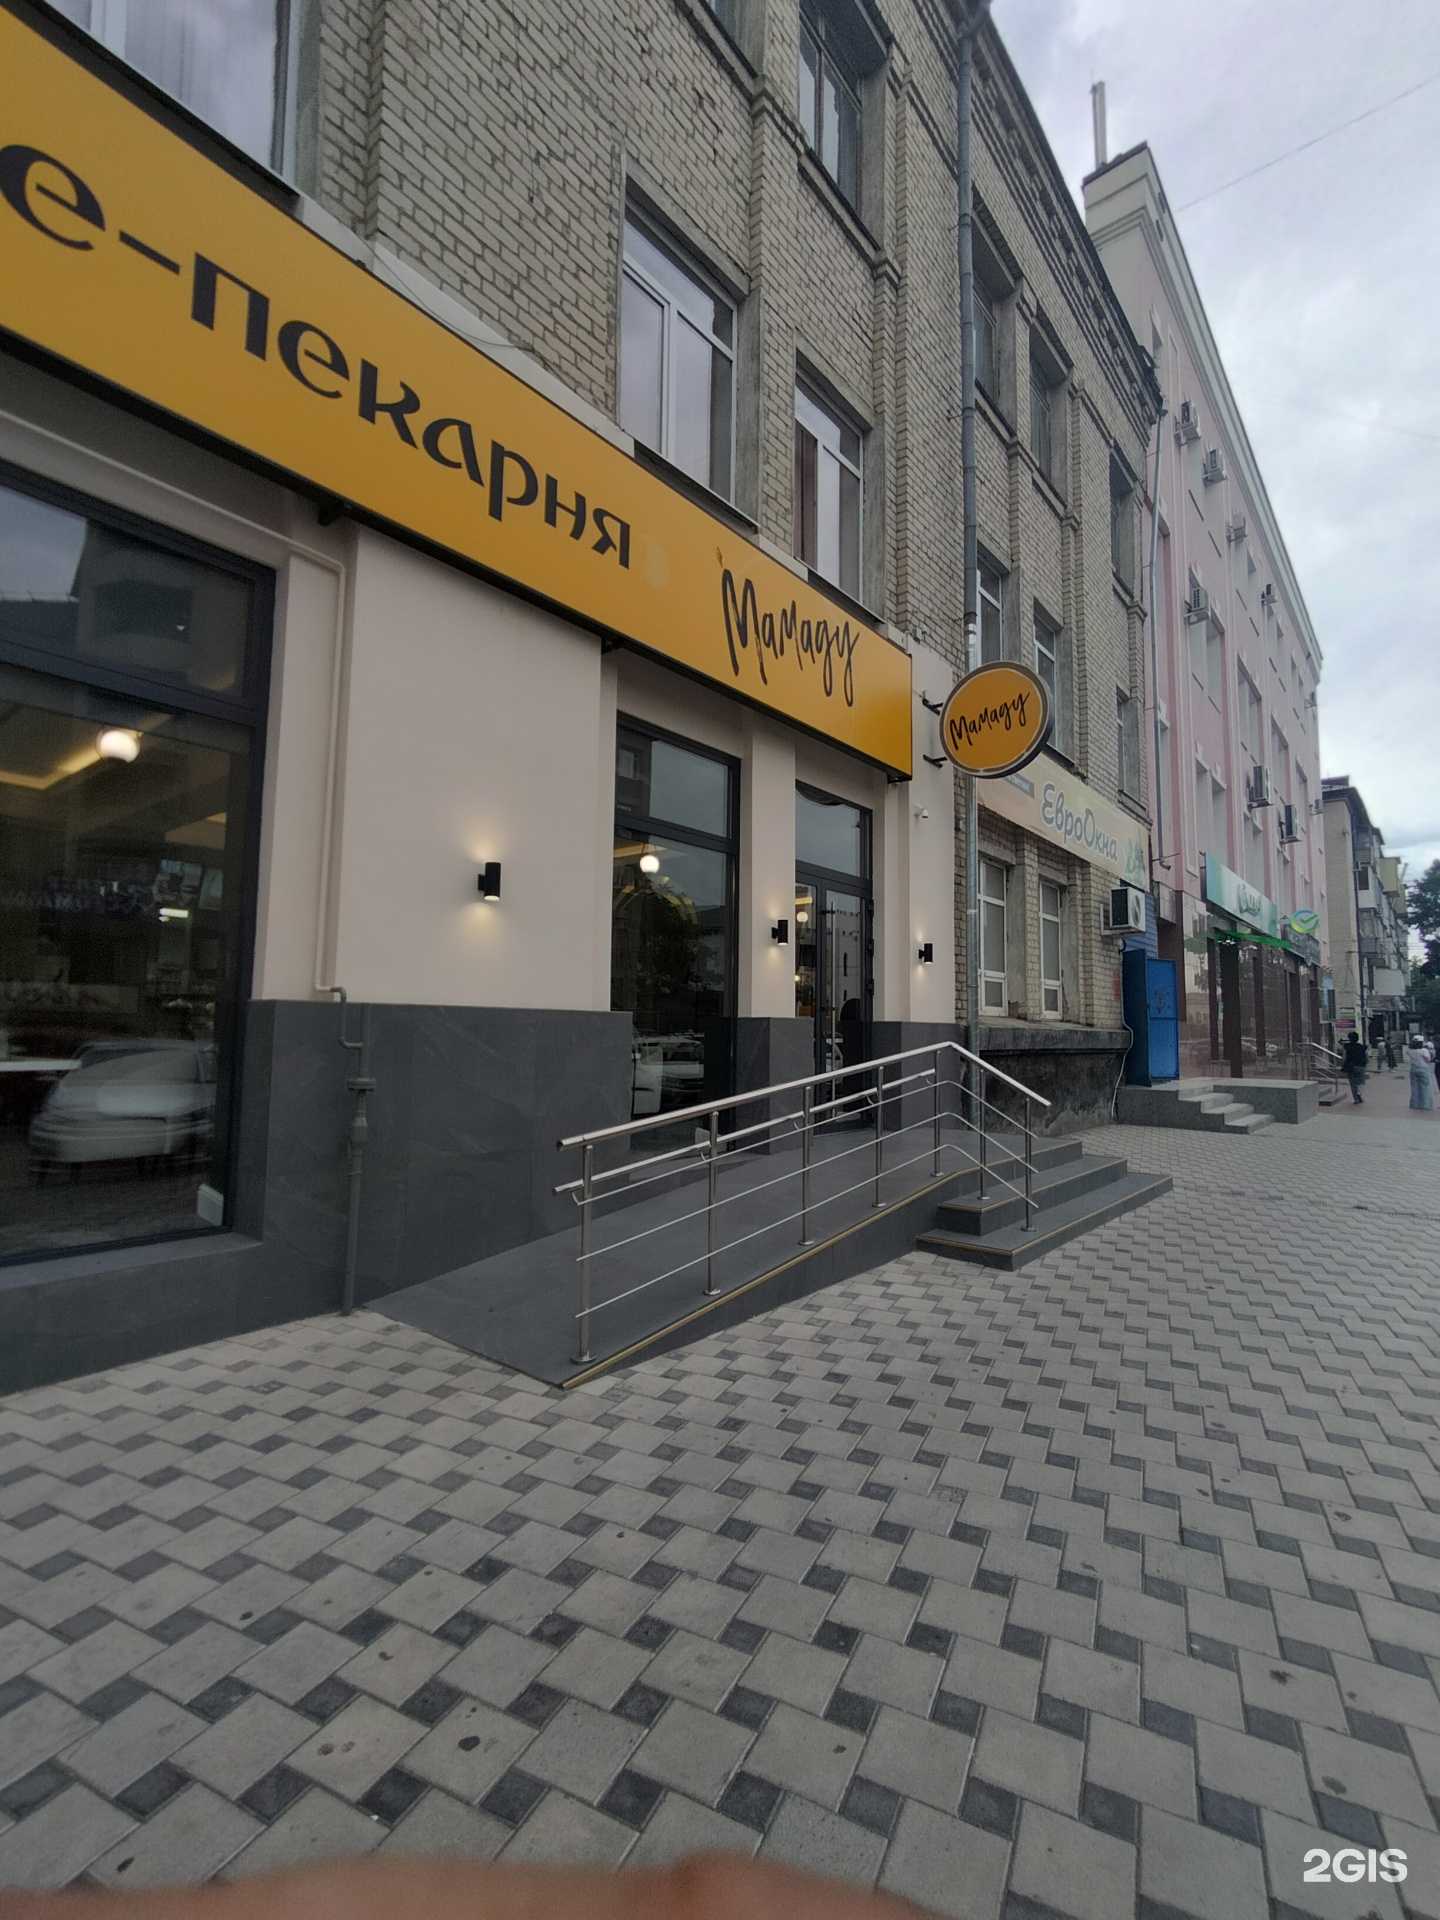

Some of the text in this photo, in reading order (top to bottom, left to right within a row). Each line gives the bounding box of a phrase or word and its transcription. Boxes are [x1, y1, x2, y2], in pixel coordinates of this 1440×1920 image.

[0, 144, 631, 569] е-пекарня
[721, 568, 861, 708] Мамаду
[949, 691, 1031, 751] Мамаду
[1040, 782, 1119, 863] ЕвроОкна
